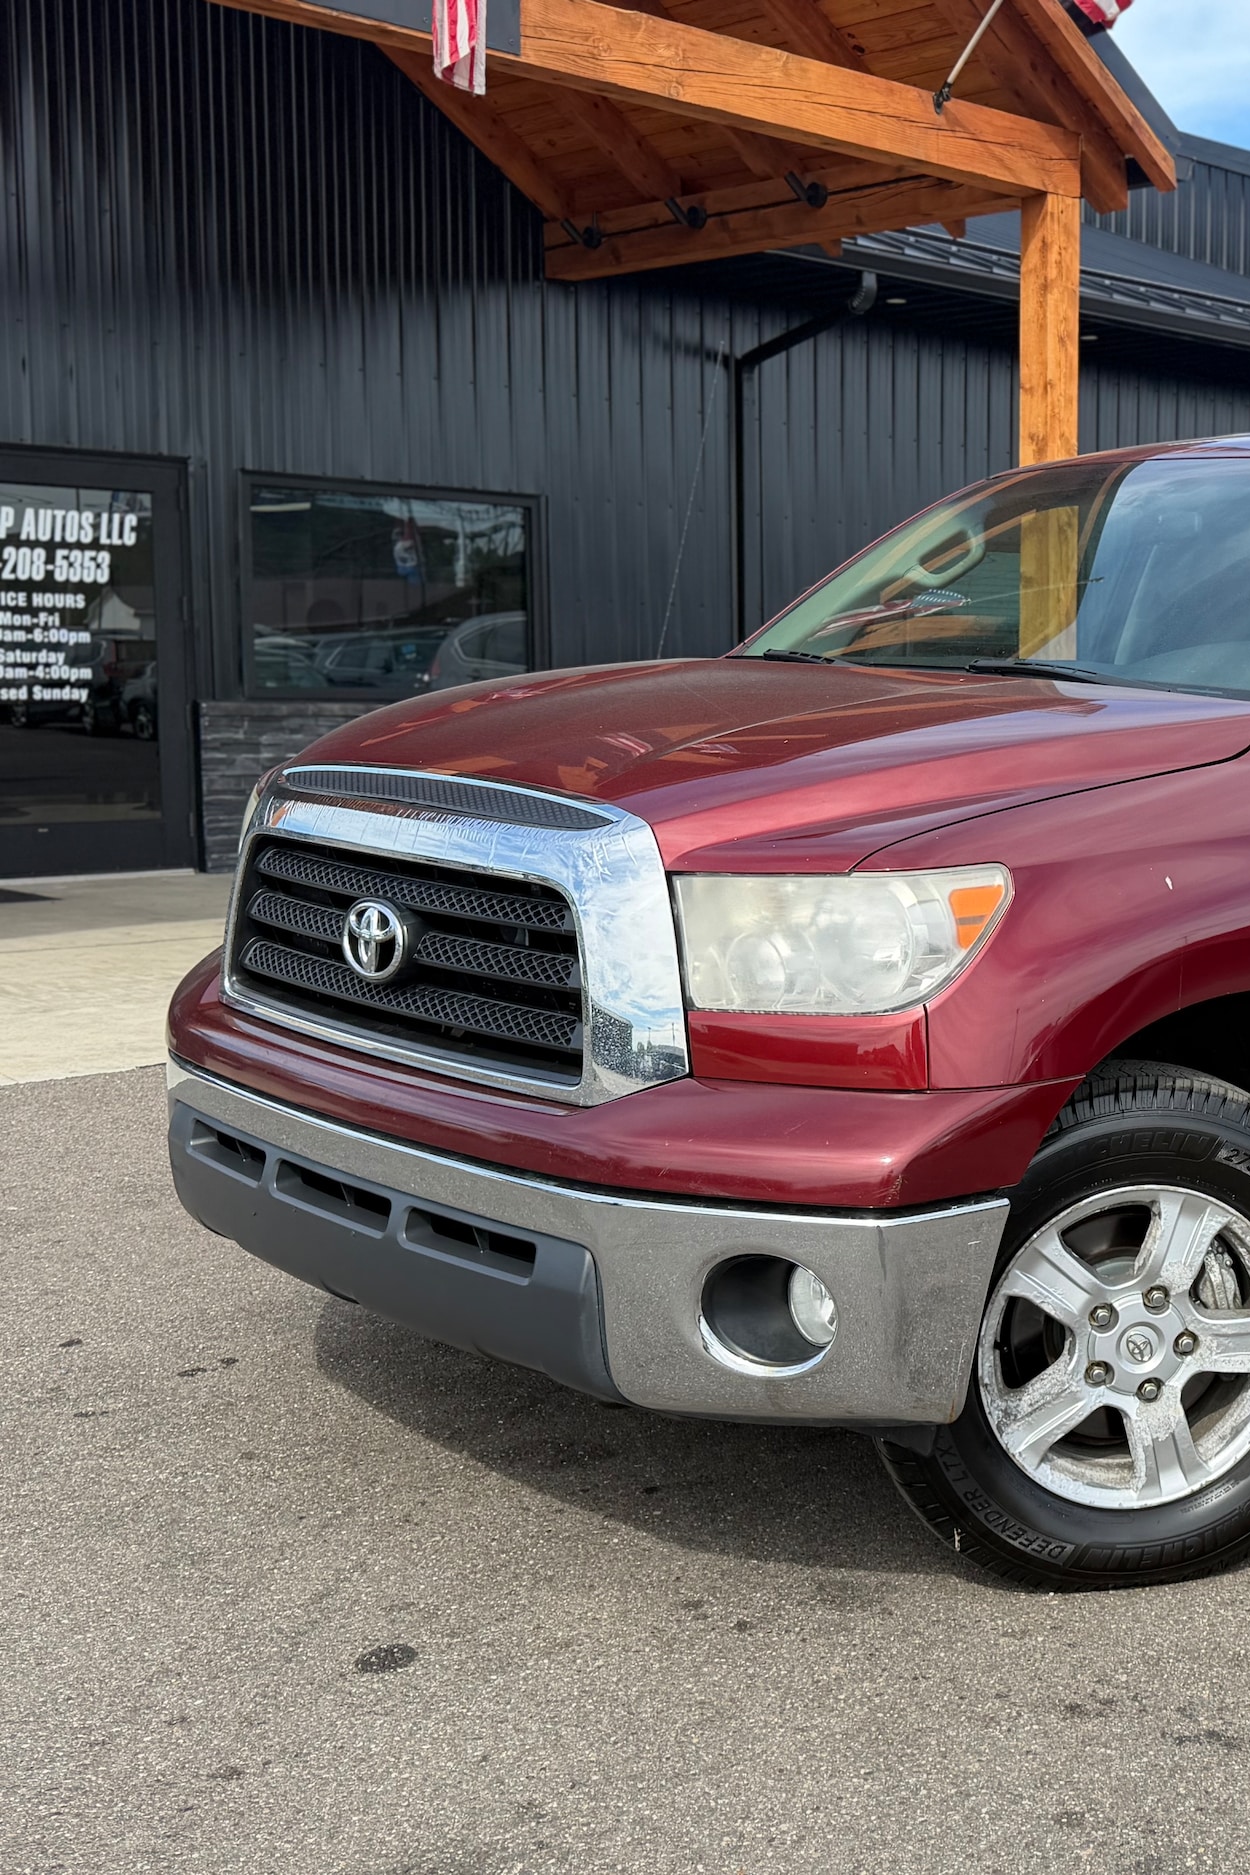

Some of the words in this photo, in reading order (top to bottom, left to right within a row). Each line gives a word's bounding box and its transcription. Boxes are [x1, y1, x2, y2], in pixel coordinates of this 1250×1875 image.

[0, 505, 15, 539] P
[20, 507, 94, 543] AUTOS
[99, 512, 138, 546] LLC
[32, 592, 86, 609] HOURS
[0, 611, 60, 628] Mon-Fri
[0, 627, 91, 646] am-6:00pm
[32, 684, 89, 704] Sunday
[1047, 1131, 1211, 1172] ICHELIN
[936, 1445, 969, 1481] LTX
[963, 1488, 1067, 1560] DEFENDER
